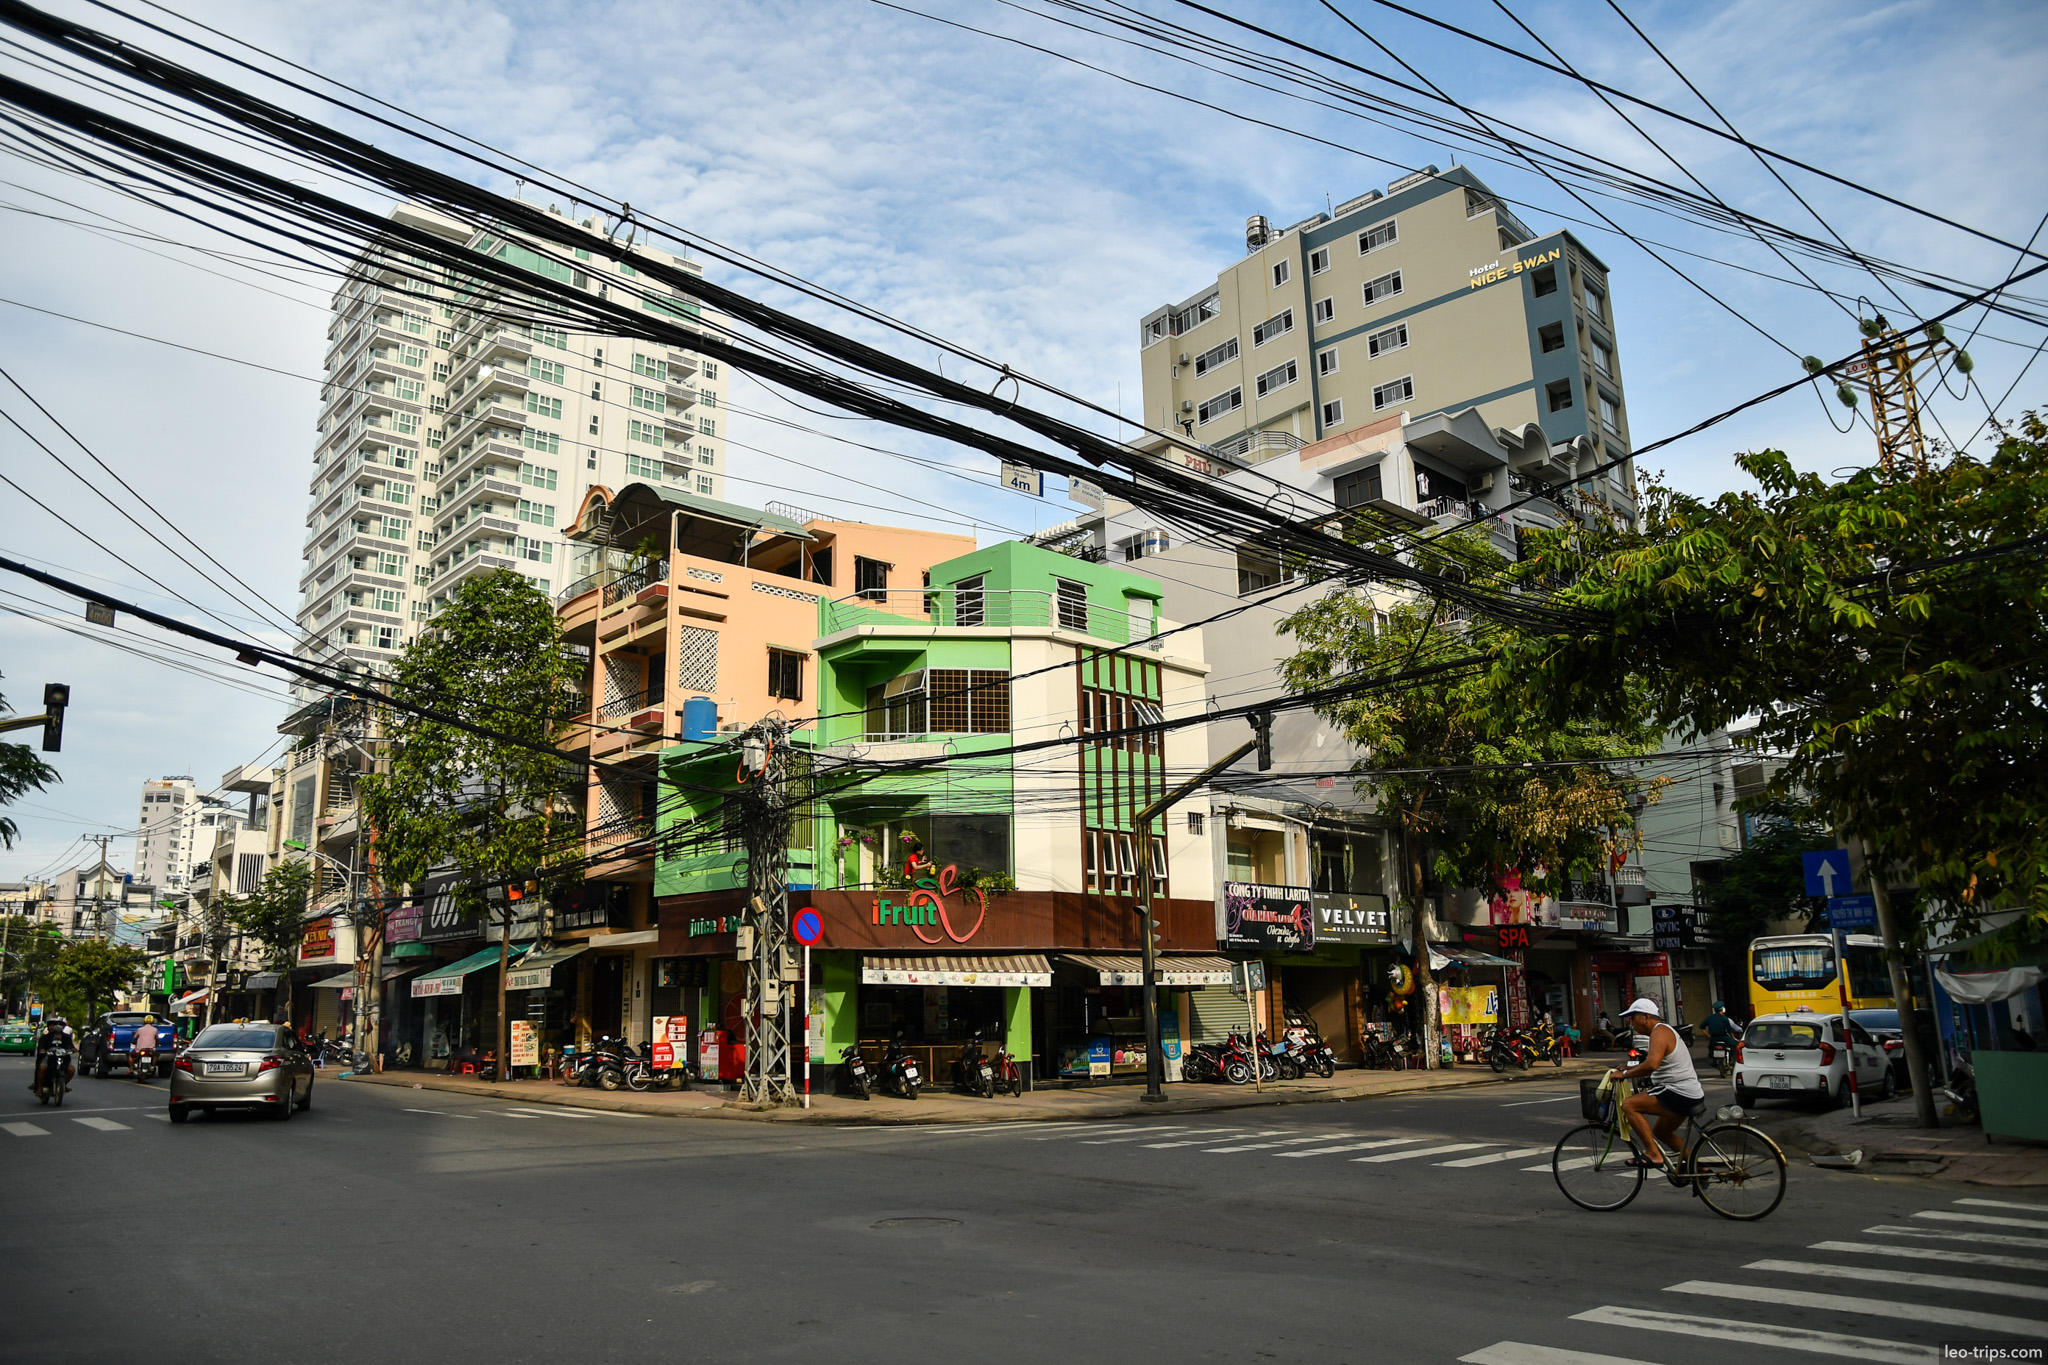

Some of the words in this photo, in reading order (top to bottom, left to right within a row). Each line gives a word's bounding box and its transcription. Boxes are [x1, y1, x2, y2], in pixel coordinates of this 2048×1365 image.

[1469, 260, 1500, 277] Hotel
[1470, 267, 1508, 290] NICE
[1512, 248, 1561, 274] SWAN
[1184, 454, 1212, 474] PHÚ
[1010, 477, 1031, 491] 4m
[1228, 882, 1251, 898] CÔNG
[1251, 885, 1261, 898] TY
[1262, 886, 1284, 900] TNHH
[1285, 888, 1310, 902] LARITA
[872, 898, 937, 925] iFruit
[1320, 908, 1387, 926] VELVET
[689, 918, 717, 938] juice
[718, 916, 728, 933] &
[1655, 920, 1680, 933] OPTIC
[1499, 928, 1529, 948] SPA
